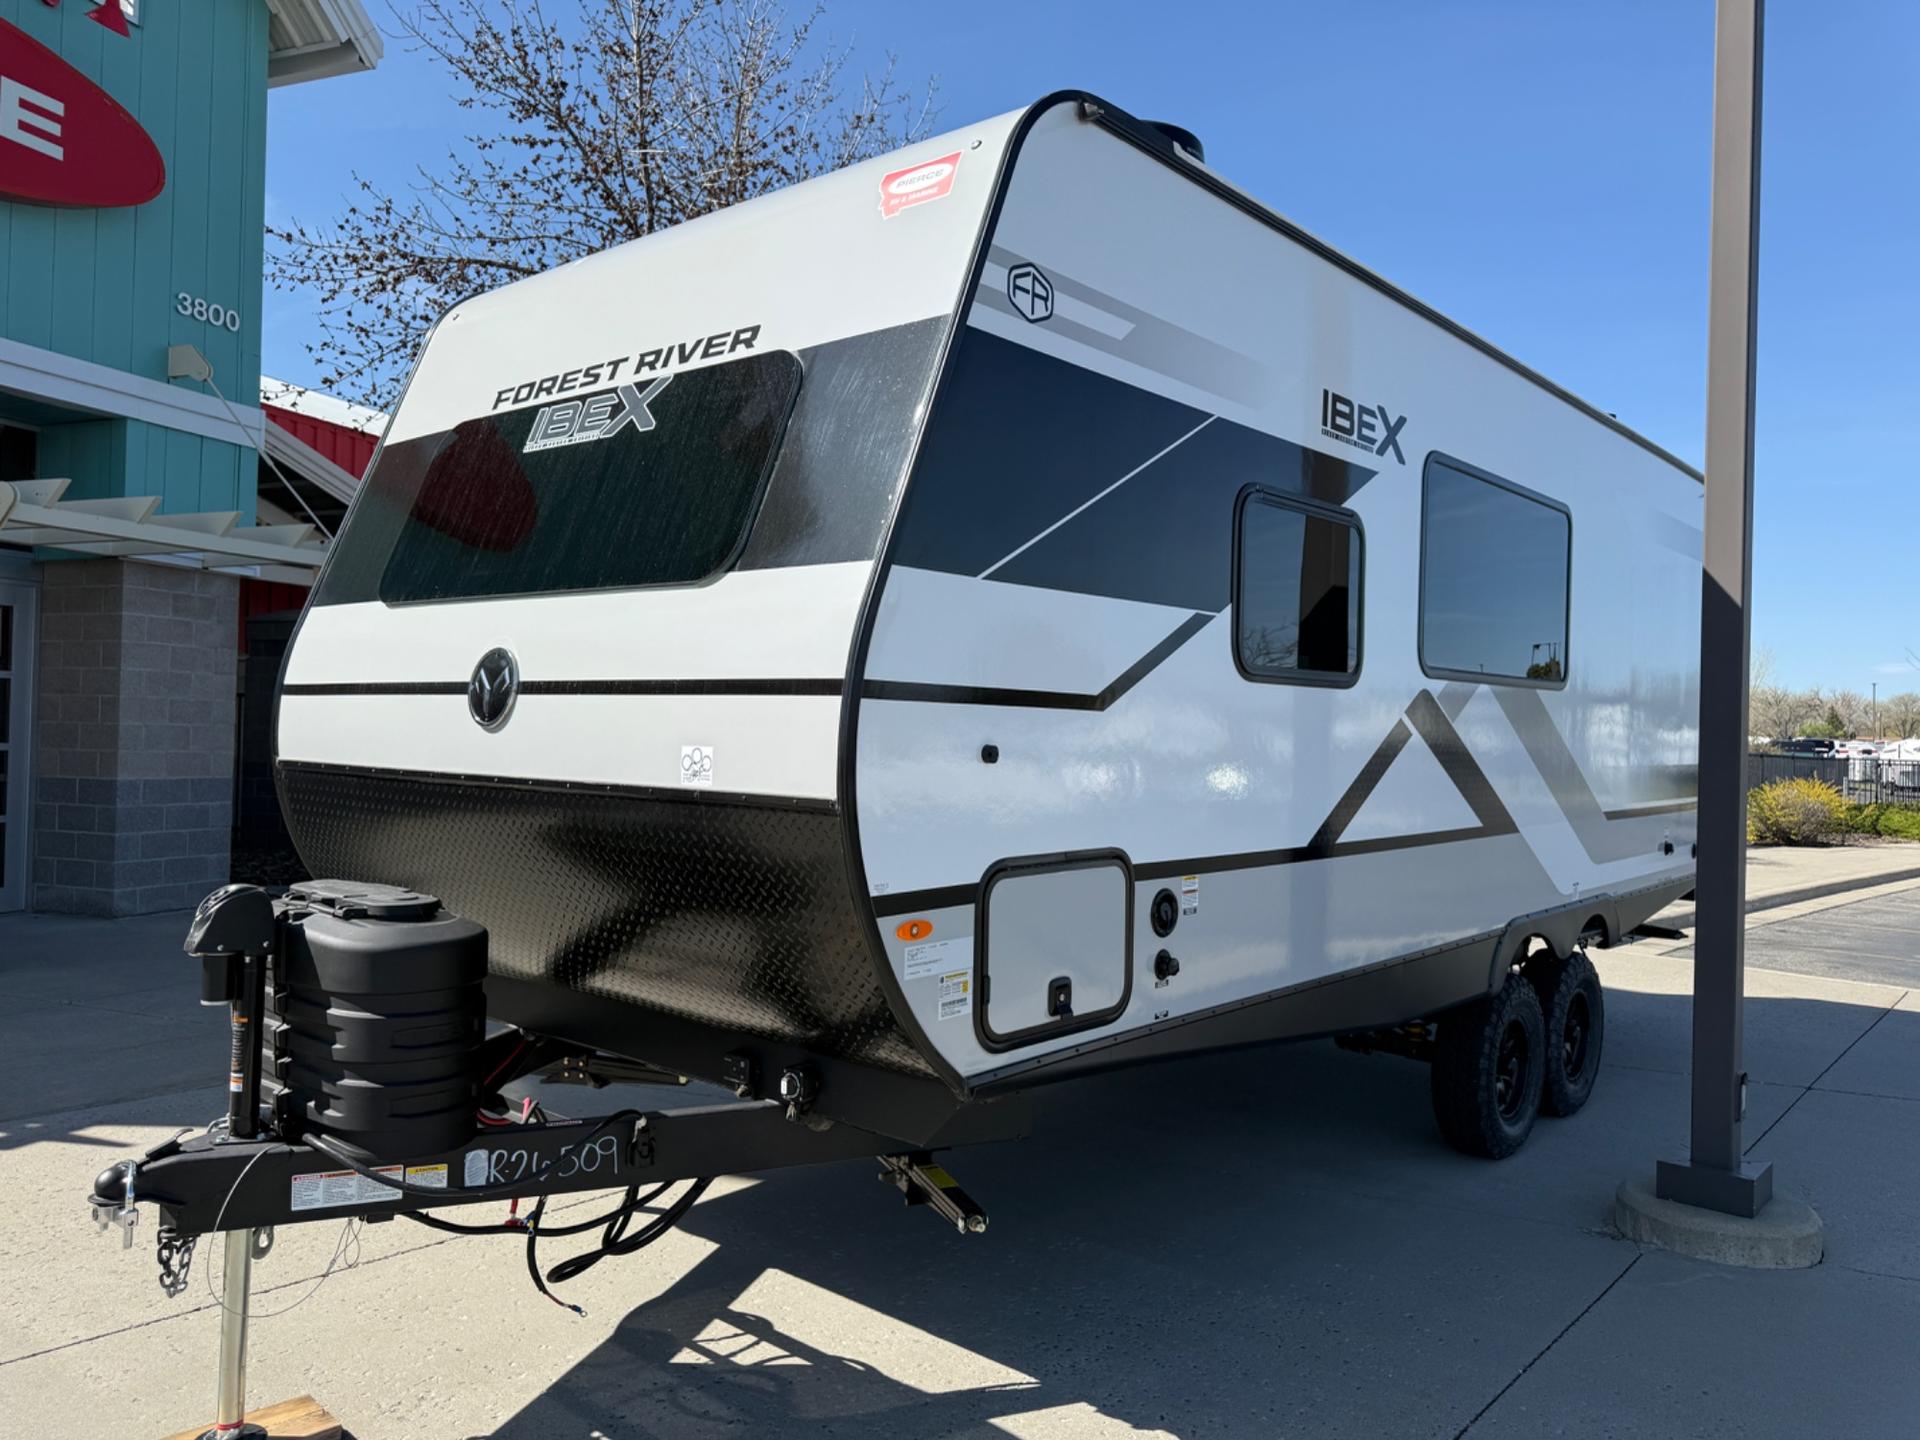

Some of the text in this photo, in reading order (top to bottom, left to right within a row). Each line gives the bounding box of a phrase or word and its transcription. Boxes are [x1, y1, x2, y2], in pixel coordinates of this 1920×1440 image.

[0, 75, 65, 162] E
[896, 167, 944, 189] PIERCE
[176, 292, 241, 332] 3800
[492, 324, 762, 410] FOREST RIVER
[525, 374, 675, 444] IBEX
[1322, 388, 1408, 466] IBEX
